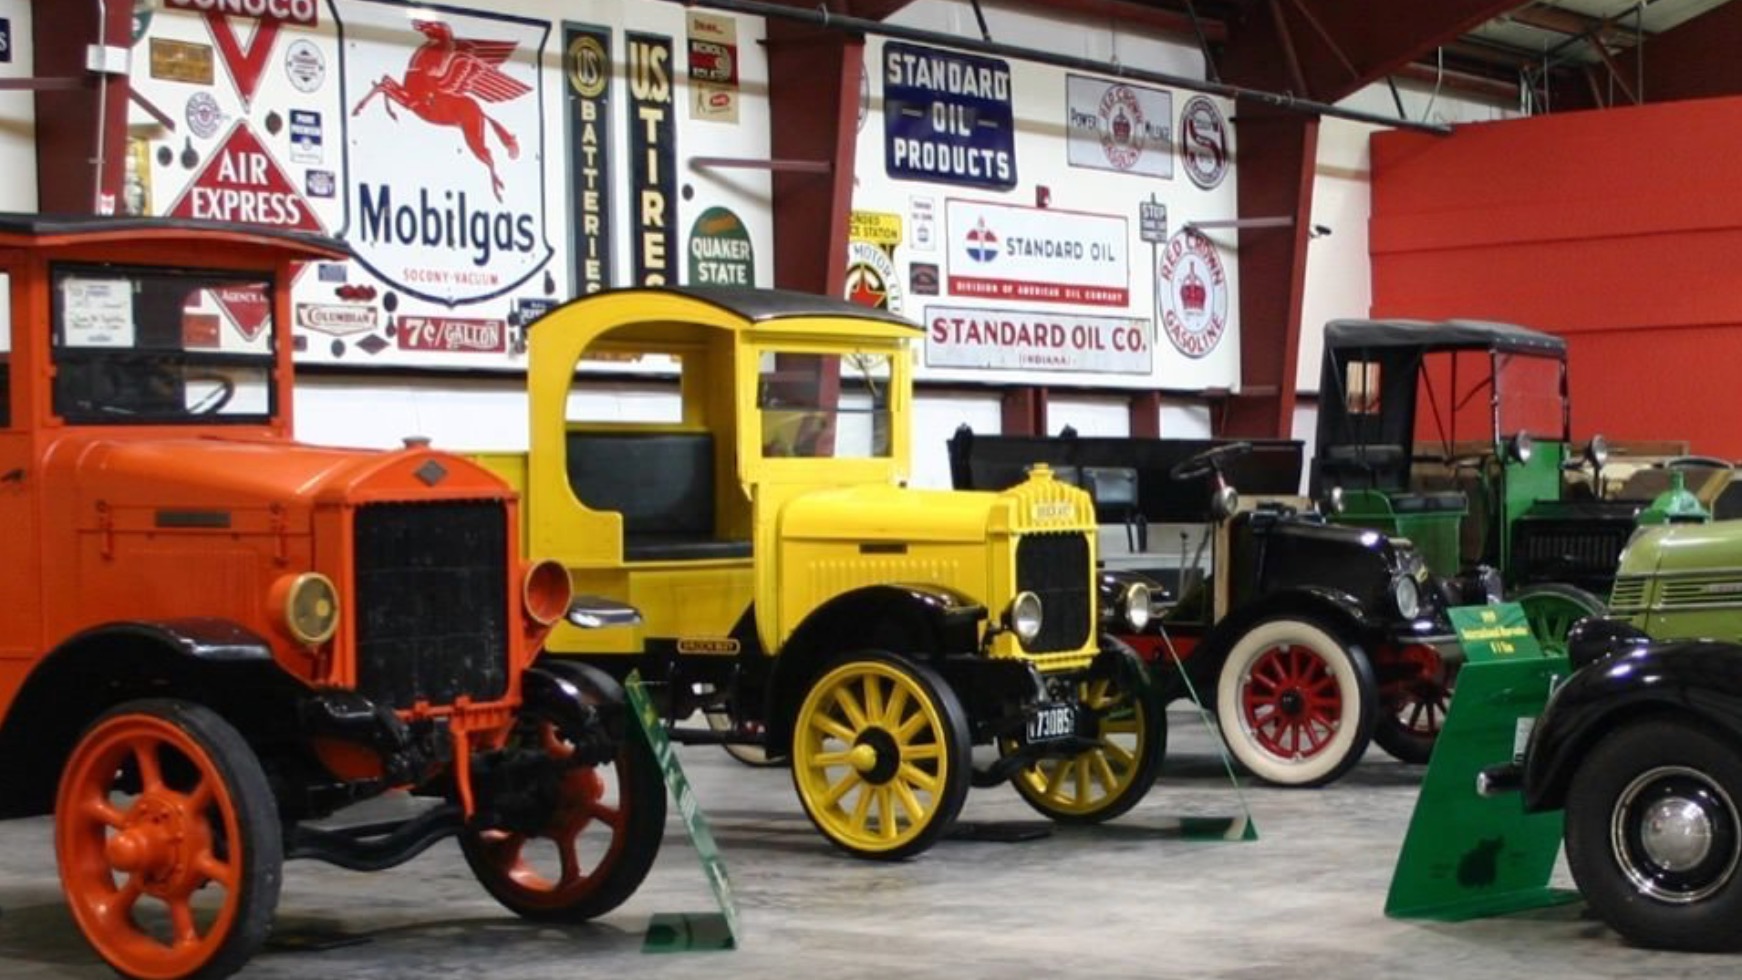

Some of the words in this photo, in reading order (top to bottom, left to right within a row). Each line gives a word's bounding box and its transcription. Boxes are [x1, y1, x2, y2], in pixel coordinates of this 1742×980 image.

[629, 41, 672, 104] U.S.
[888, 52, 1010, 100] STANDARD
[932, 101, 972, 137] OIL
[217, 148, 269, 186] AIR
[894, 137, 1010, 180] PRODUCTS
[192, 187, 301, 225] EXPRESS
[358, 182, 535, 266] Mobilgas
[692, 237, 750, 261] QUAKER
[863, 225, 898, 239] STATION
[1006, 237, 1083, 259] STANDARD
[1090, 242, 1116, 262] OIL
[698, 262, 748, 284] STATE
[854, 244, 892, 277] MOTOR
[1161, 239, 1182, 281] RED
[956, 280, 998, 293] DIVISION
[1002, 284, 1013, 294] OF
[1018, 284, 1060, 297] AMERICAN
[1065, 288, 1081, 299] OIL
[1085, 290, 1122, 302] COMPANY
[307, 308, 371, 325] COLUMBIAN
[1165, 309, 1223, 353] GASOLINE
[932, 318, 1066, 348] STANDARD
[1071, 325, 1106, 350] OIL
[1112, 327, 1147, 352] CO.
